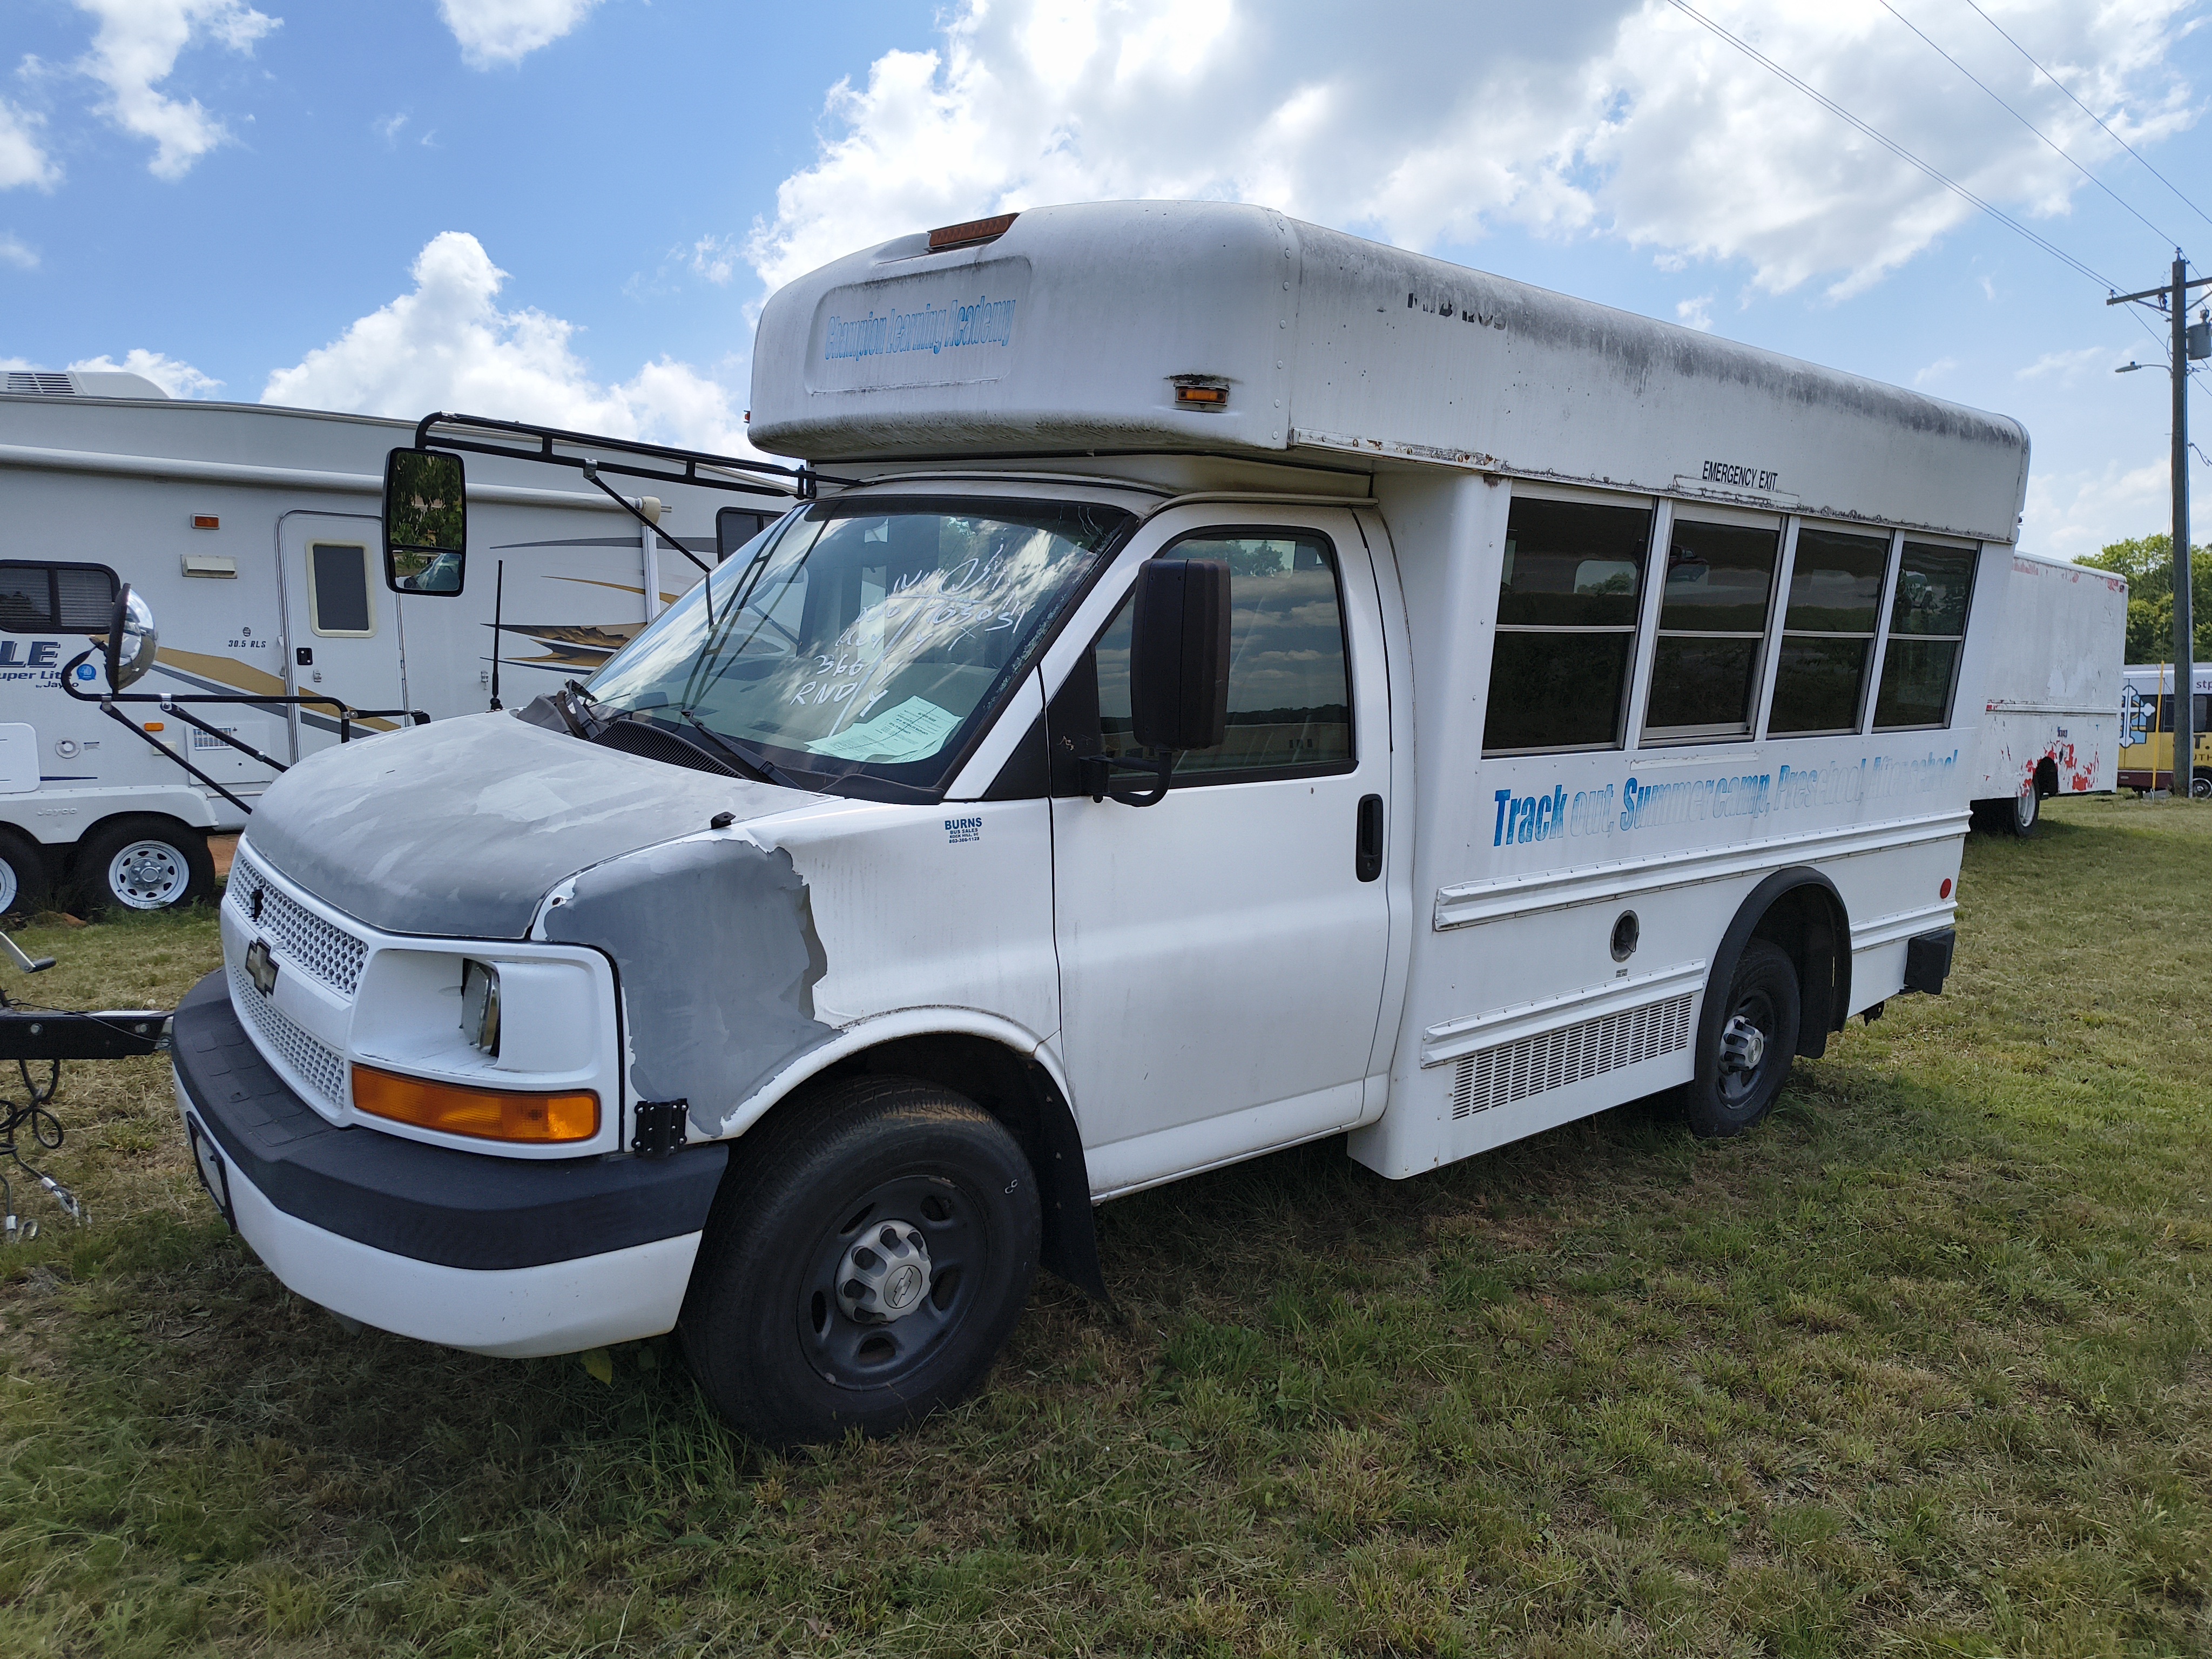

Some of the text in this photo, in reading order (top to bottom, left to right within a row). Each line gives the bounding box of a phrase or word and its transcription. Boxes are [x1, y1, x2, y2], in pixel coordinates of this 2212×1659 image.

[825, 296, 1016, 361] Champion Learning Academy
[1702, 460, 1778, 491] EMERGENCY EXIT
[945, 817, 982, 830] BURNS
[1493, 784, 1568, 847] Track
